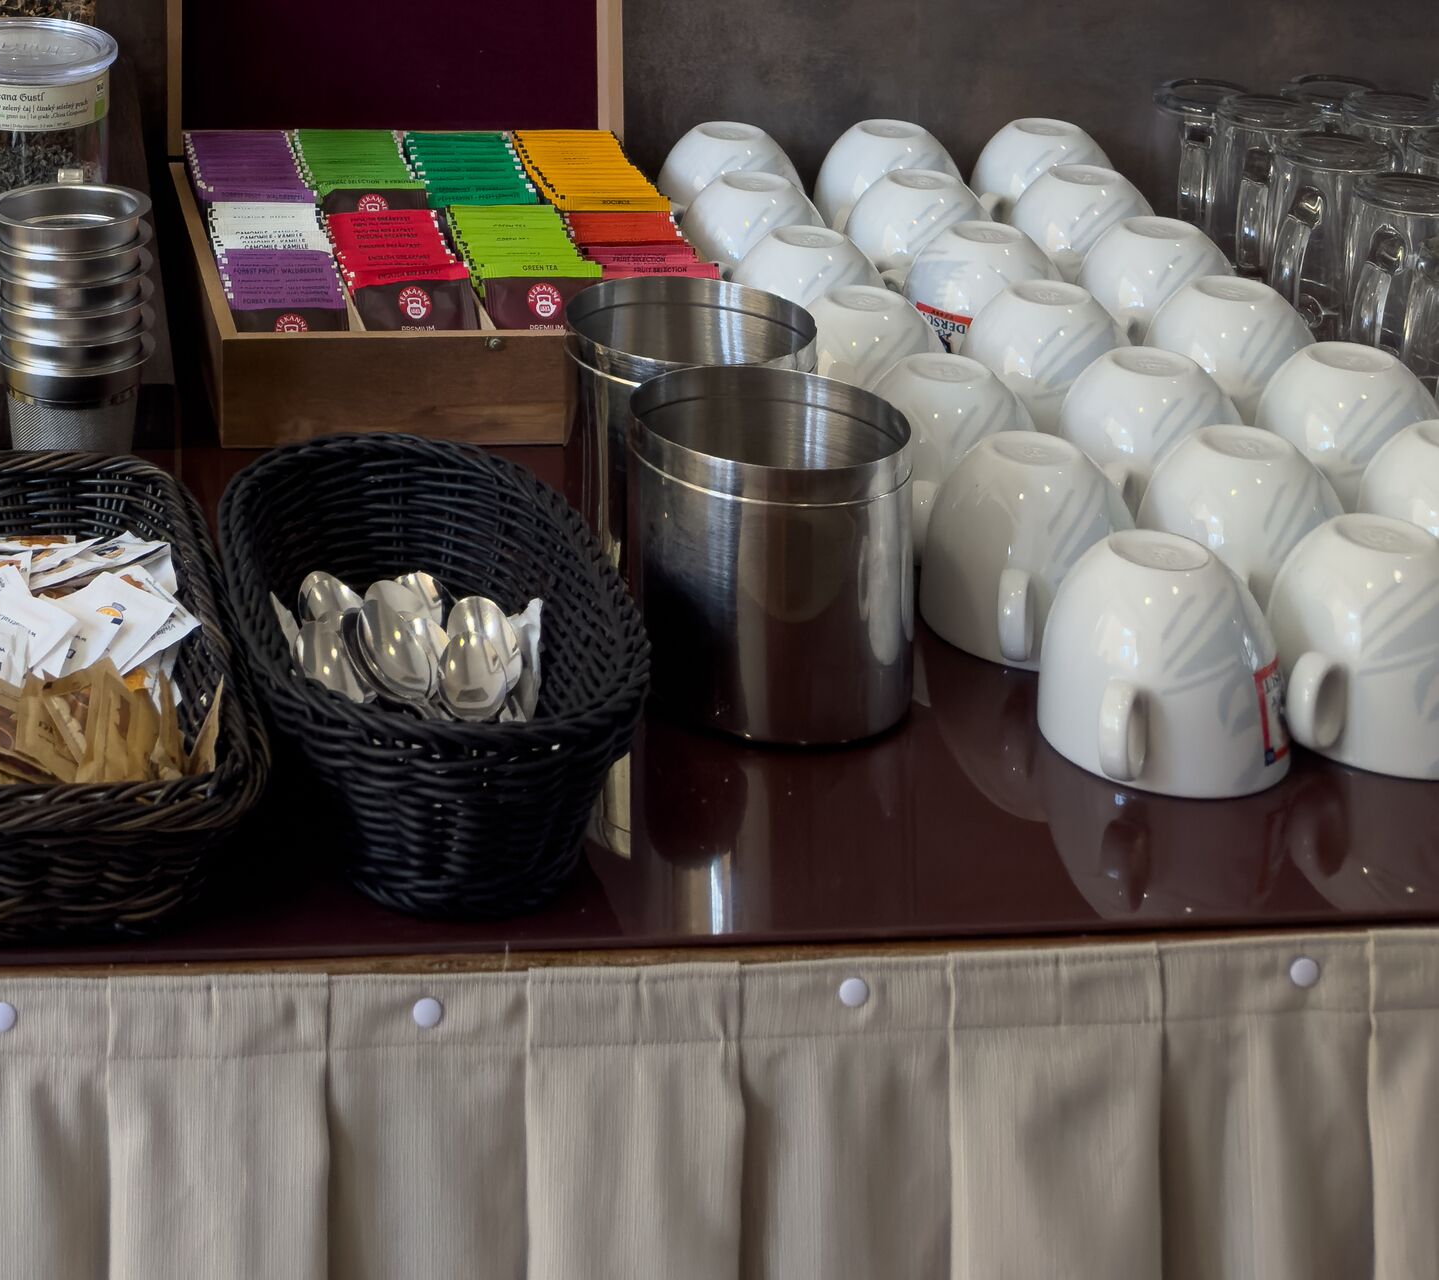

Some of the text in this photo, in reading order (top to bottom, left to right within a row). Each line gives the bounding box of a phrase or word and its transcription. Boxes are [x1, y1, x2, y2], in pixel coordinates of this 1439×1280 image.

[522, 264, 544, 272] GREEN
[399, 288, 431, 306] TEEKANNE
[528, 283, 561, 303] TEEKANNE
[275, 315, 308, 332] TEEKANNE
[920, 312, 966, 335] DERSU
